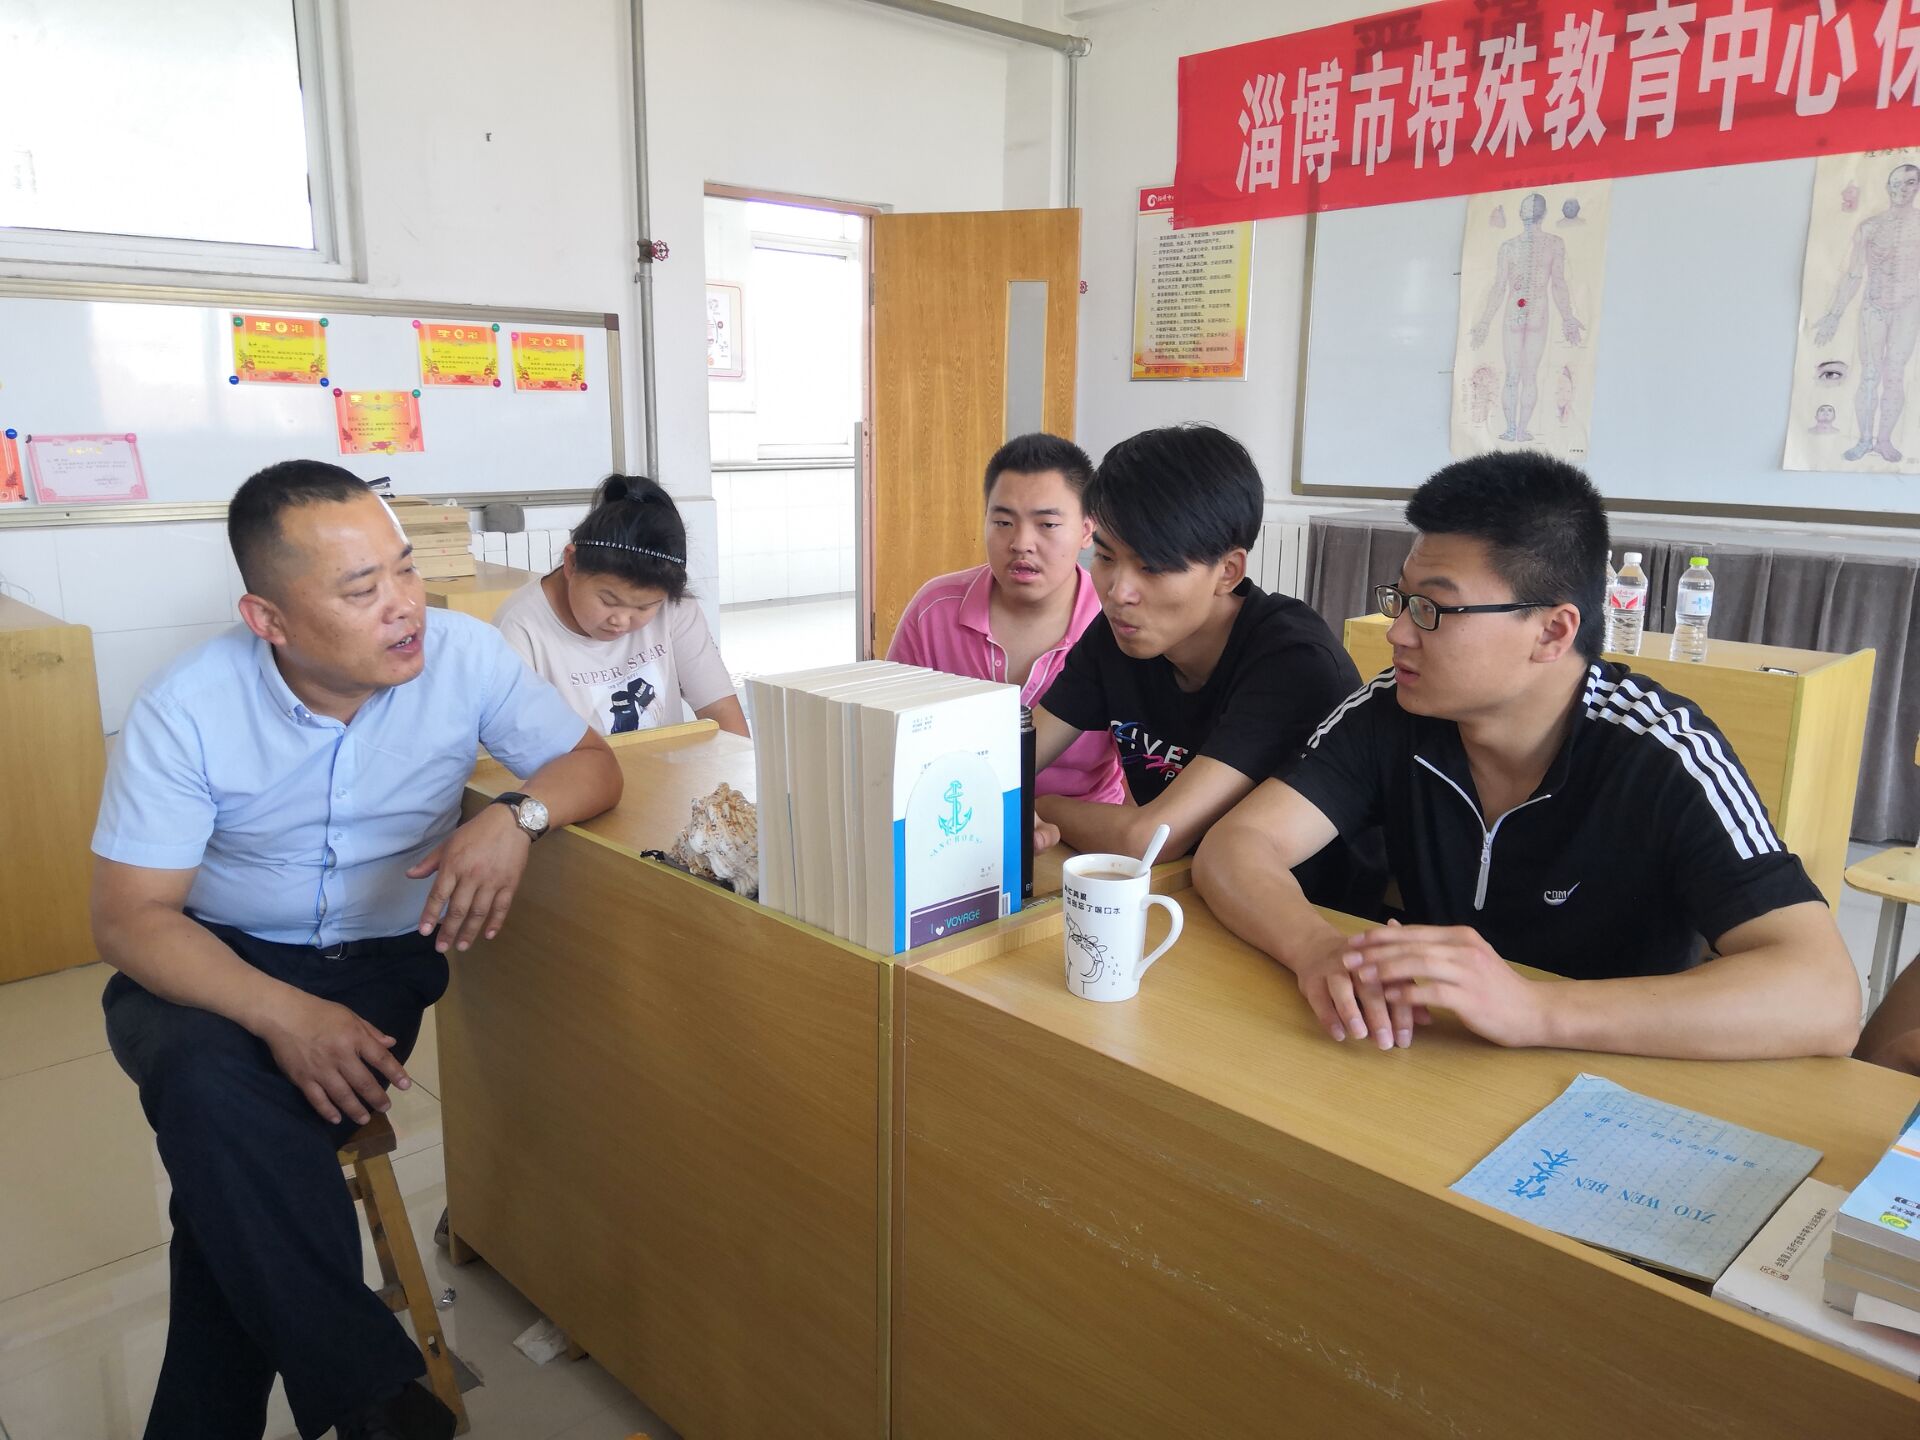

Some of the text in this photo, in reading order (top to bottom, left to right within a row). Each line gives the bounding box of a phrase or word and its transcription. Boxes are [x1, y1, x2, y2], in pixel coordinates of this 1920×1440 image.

[570, 666, 623, 686] SUPER
[627, 644, 667, 671] STAR
[945, 909, 981, 928] VOYAGE
[1508, 1148, 1578, 1200] 作文本
[1573, 1175, 1717, 1225] ZUO WEN BEN
